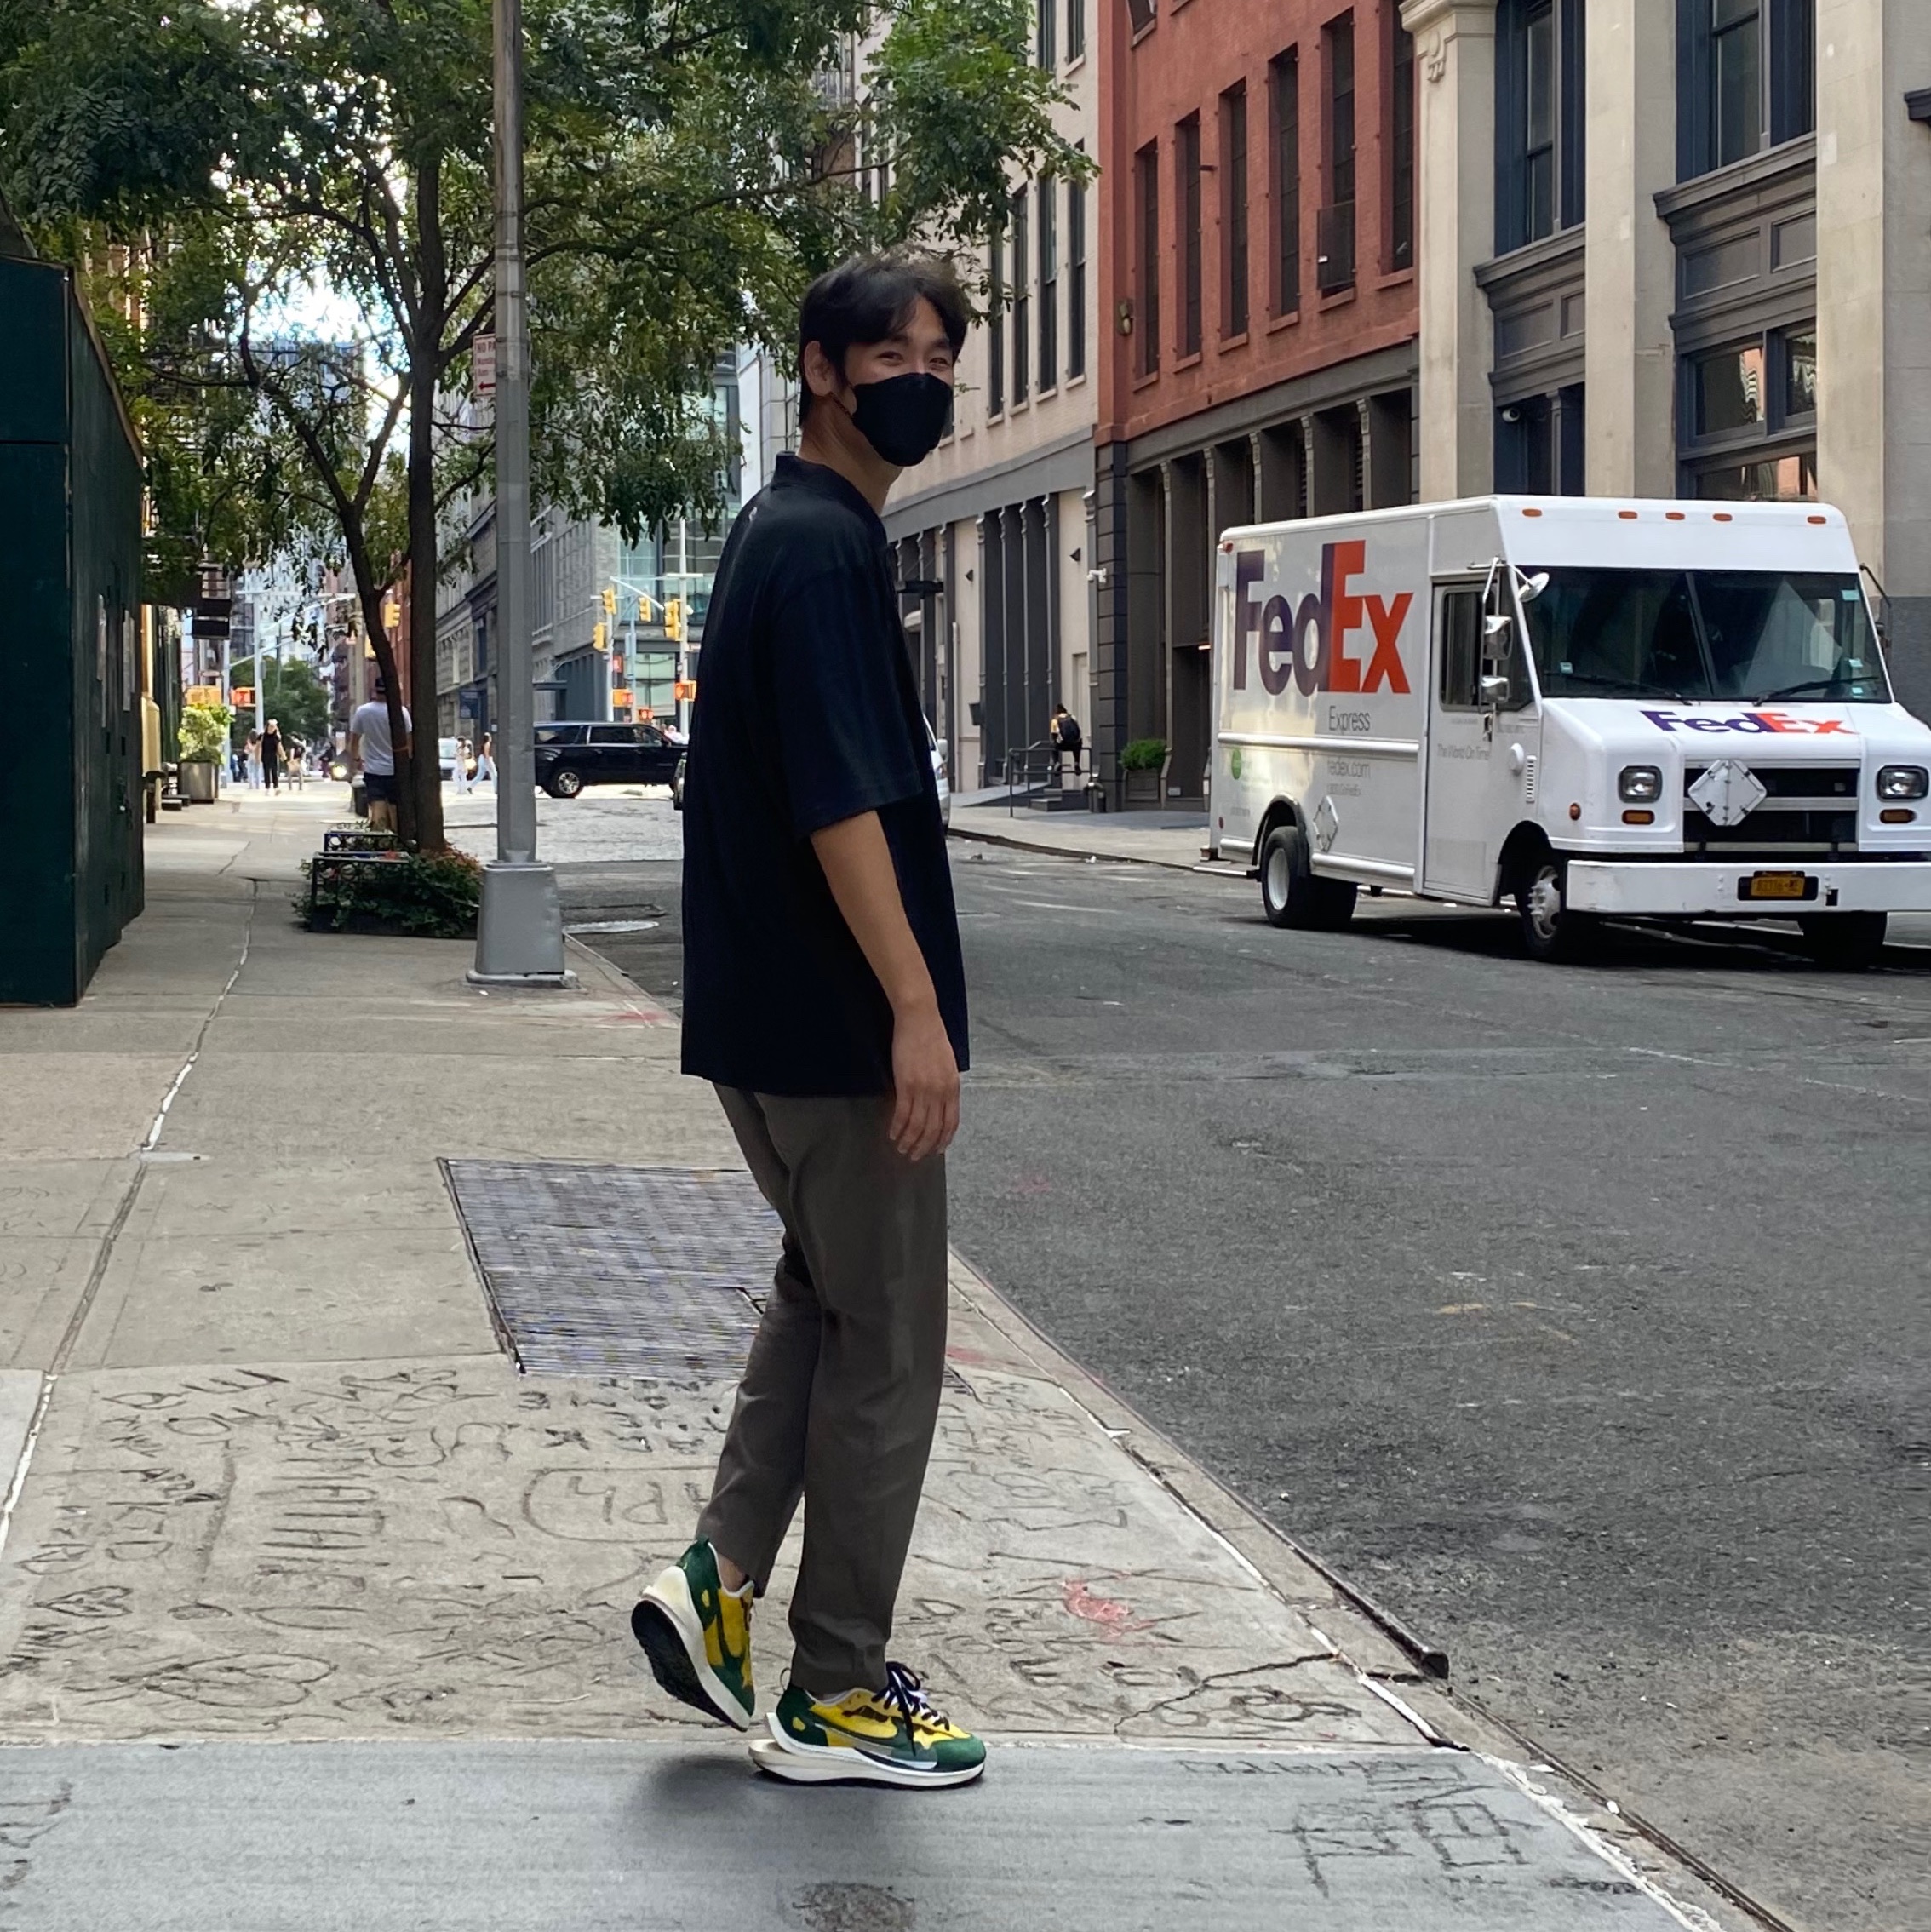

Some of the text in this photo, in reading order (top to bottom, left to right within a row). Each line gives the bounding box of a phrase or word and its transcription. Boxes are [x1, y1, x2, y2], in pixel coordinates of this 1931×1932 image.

[1233, 539, 1414, 697] FedEx
[1328, 705, 1371, 734] Express
[1640, 709, 1861, 735] FedEx
